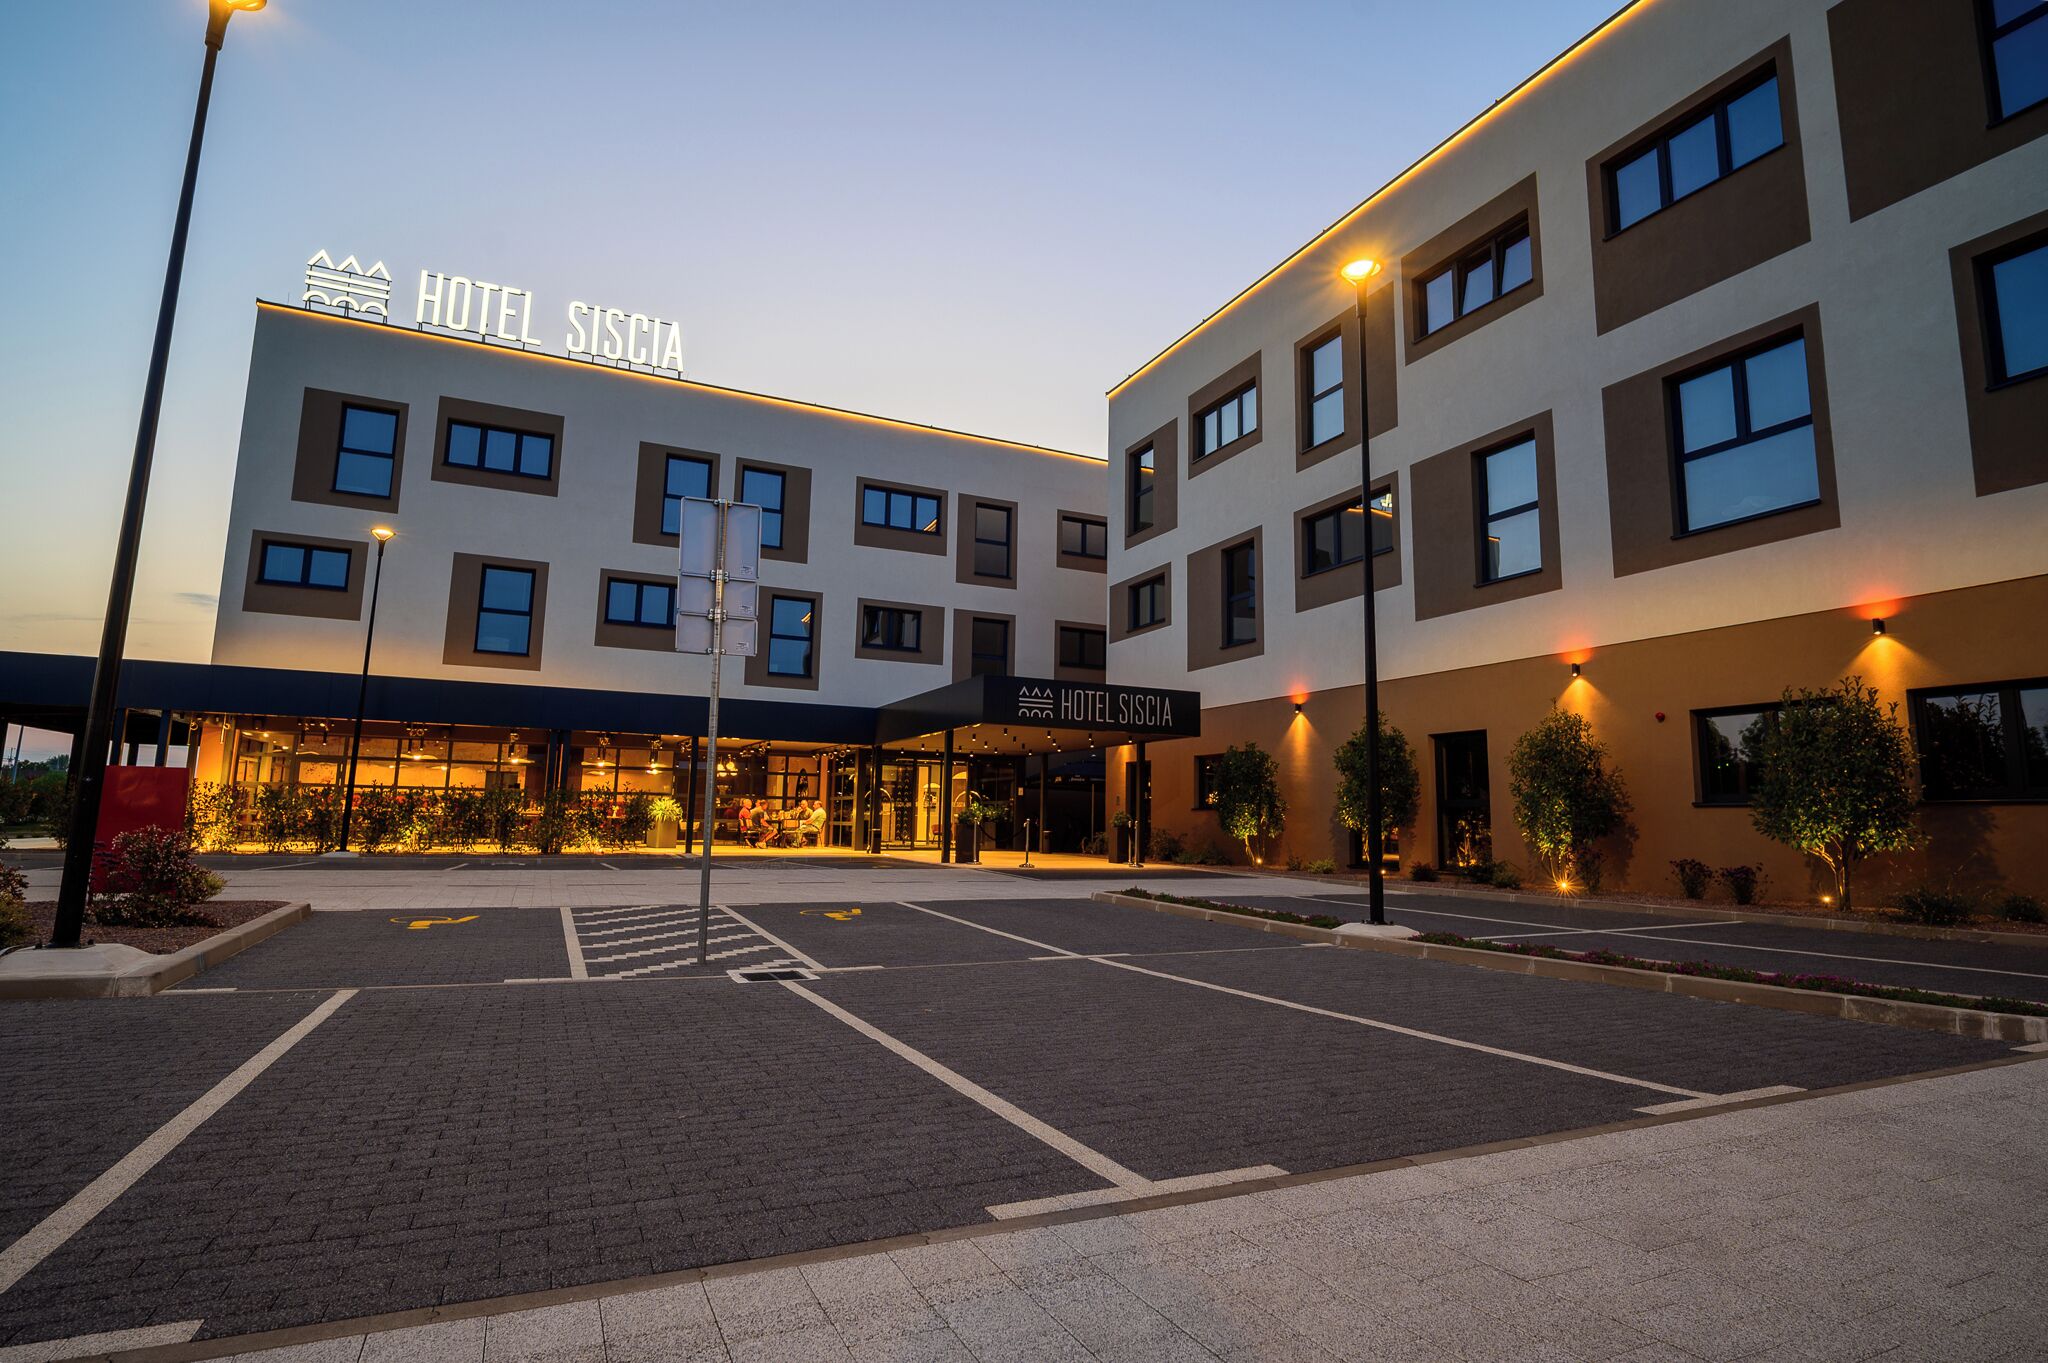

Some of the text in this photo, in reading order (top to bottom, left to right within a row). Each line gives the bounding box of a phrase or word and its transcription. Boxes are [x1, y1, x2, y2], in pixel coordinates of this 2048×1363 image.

[416, 269, 684, 372] HOTEL SISCIA
[1061, 688, 1173, 727] HOTEL SISCIA
